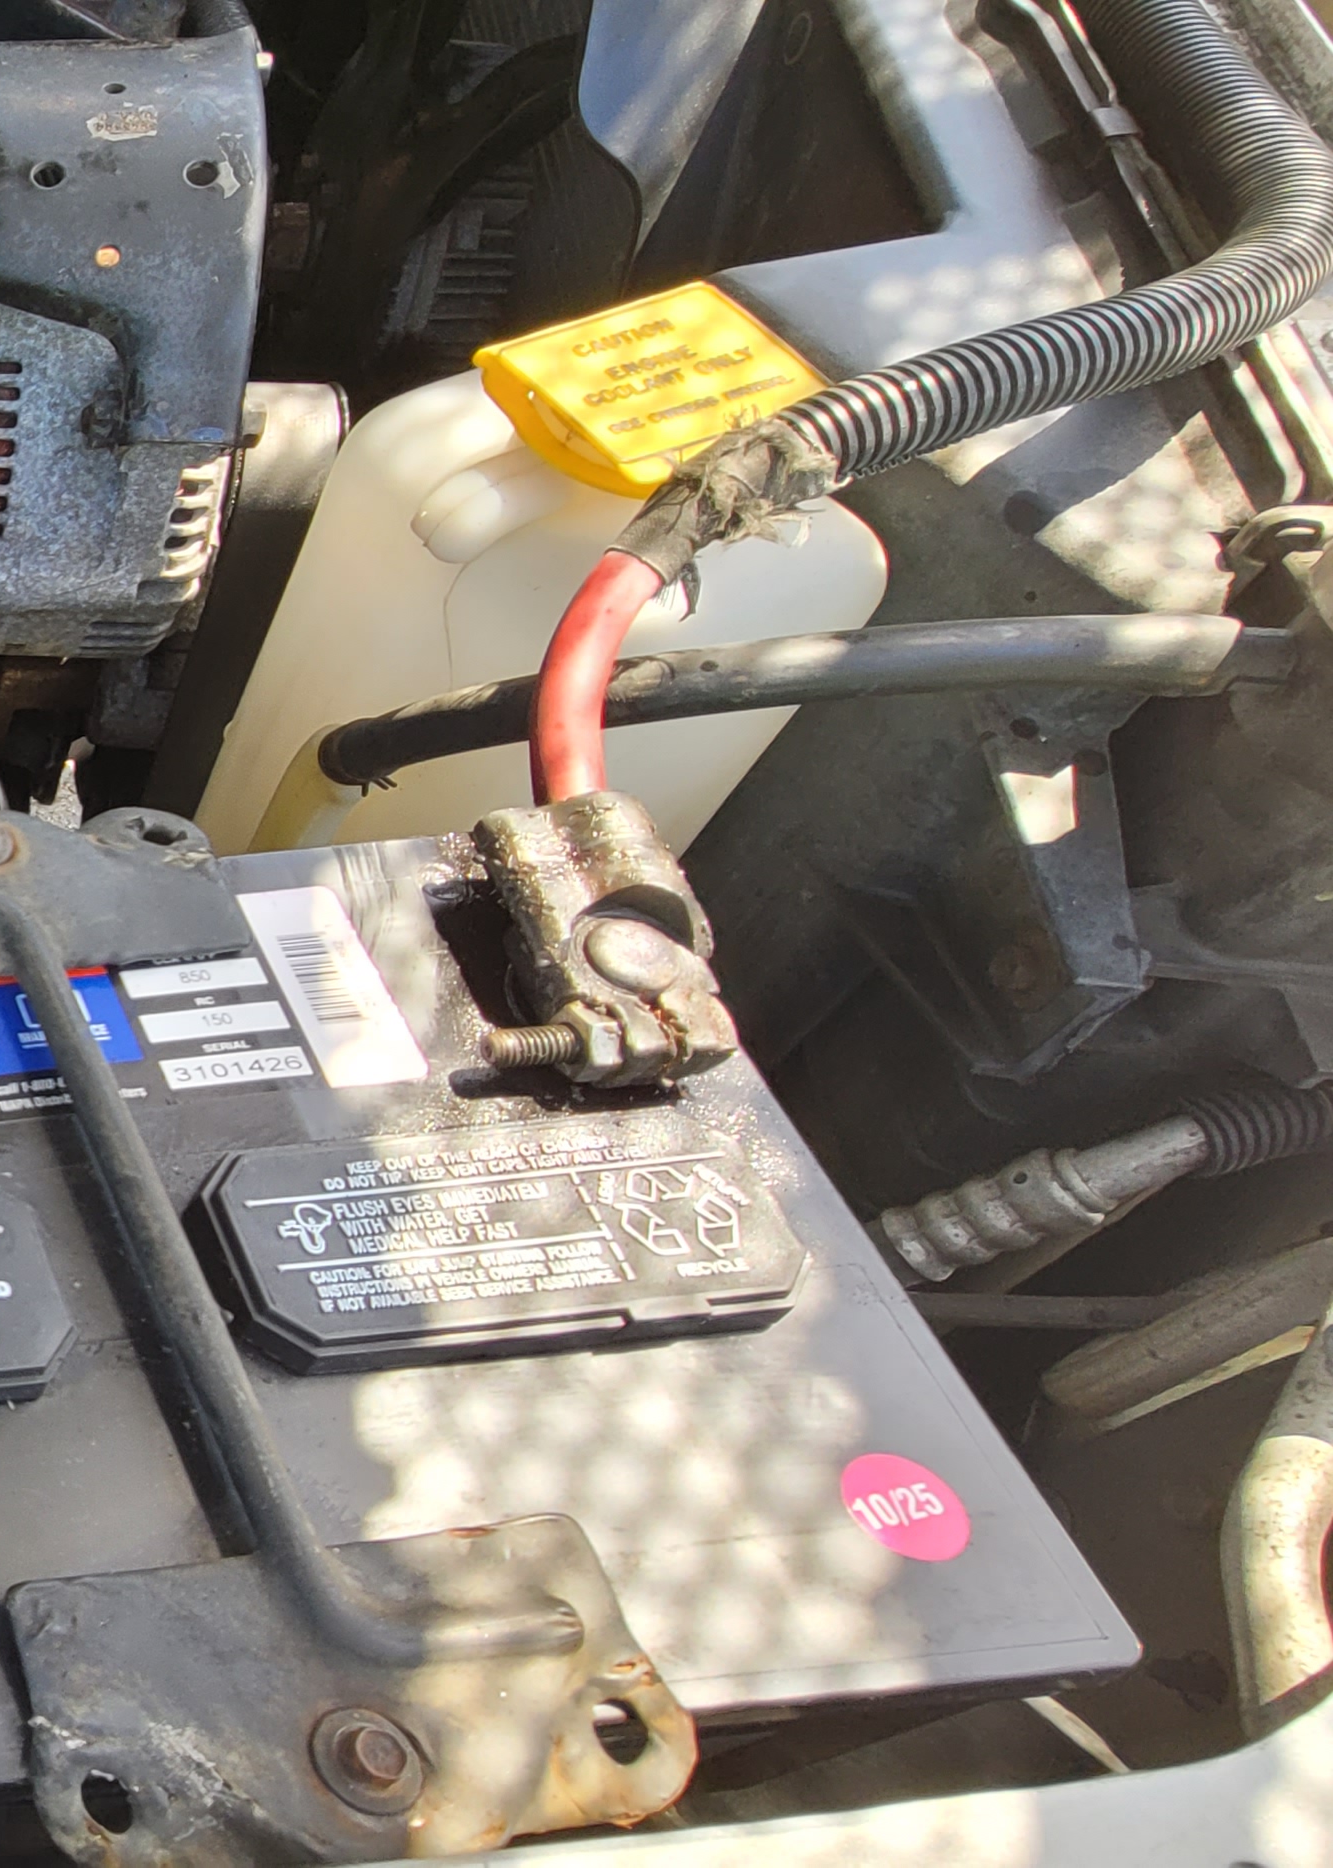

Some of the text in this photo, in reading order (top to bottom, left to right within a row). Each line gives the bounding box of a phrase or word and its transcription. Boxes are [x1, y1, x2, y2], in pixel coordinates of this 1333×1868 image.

[572, 318, 675, 357] CAUTION
[583, 346, 754, 406] COOLANT ONLY
[605, 344, 697, 380] ENGINE
[178, 969, 212, 984] 850
[193, 995, 215, 1007] RC
[201, 1013, 234, 1027] 150
[201, 1039, 252, 1054] SERIAL
[173, 1055, 303, 1083] 3101426
[323, 1177, 345, 1191] DO
[348, 1174, 376, 1189] NOT
[410, 1167, 446, 1183] KEEP
[447, 1163, 485, 1178] VENT
[527, 1151, 569, 1169] TIGHT
[573, 1149, 602, 1164] AND
[346, 1161, 382, 1175] KEEP
[385, 1156, 414, 1171] OUT
[417, 1152, 437, 1167] OF
[437, 1149, 469, 1165] THE
[471, 1144, 517, 1161] REACH
[519, 1141, 540, 1156] OF
[332, 1181, 550, 1220] FLUSH EYES IMMEDIATELY
[338, 1217, 387, 1238] WITH
[454, 1206, 490, 1224] GET
[347, 1221, 519, 1255] MEDICAL HELP FAST
[309, 1240, 603, 1285] CAUTION: FOR SAFE JUMP STARTING FOLLOW
[676, 1257, 750, 1278] RECYCLE
[316, 1275, 414, 1299] INSTRUCTIONS
[414, 1274, 433, 1290] IN
[433, 1268, 489, 1287] VEHICLE
[318, 1299, 336, 1314] IF
[336, 1296, 367, 1313] NOT
[370, 1289, 439, 1310] AVAILABLE
[438, 1285, 476, 1302] SEEK
[477, 1278, 534, 1299] SERVICE
[852, 1481, 945, 1530] 10/25
